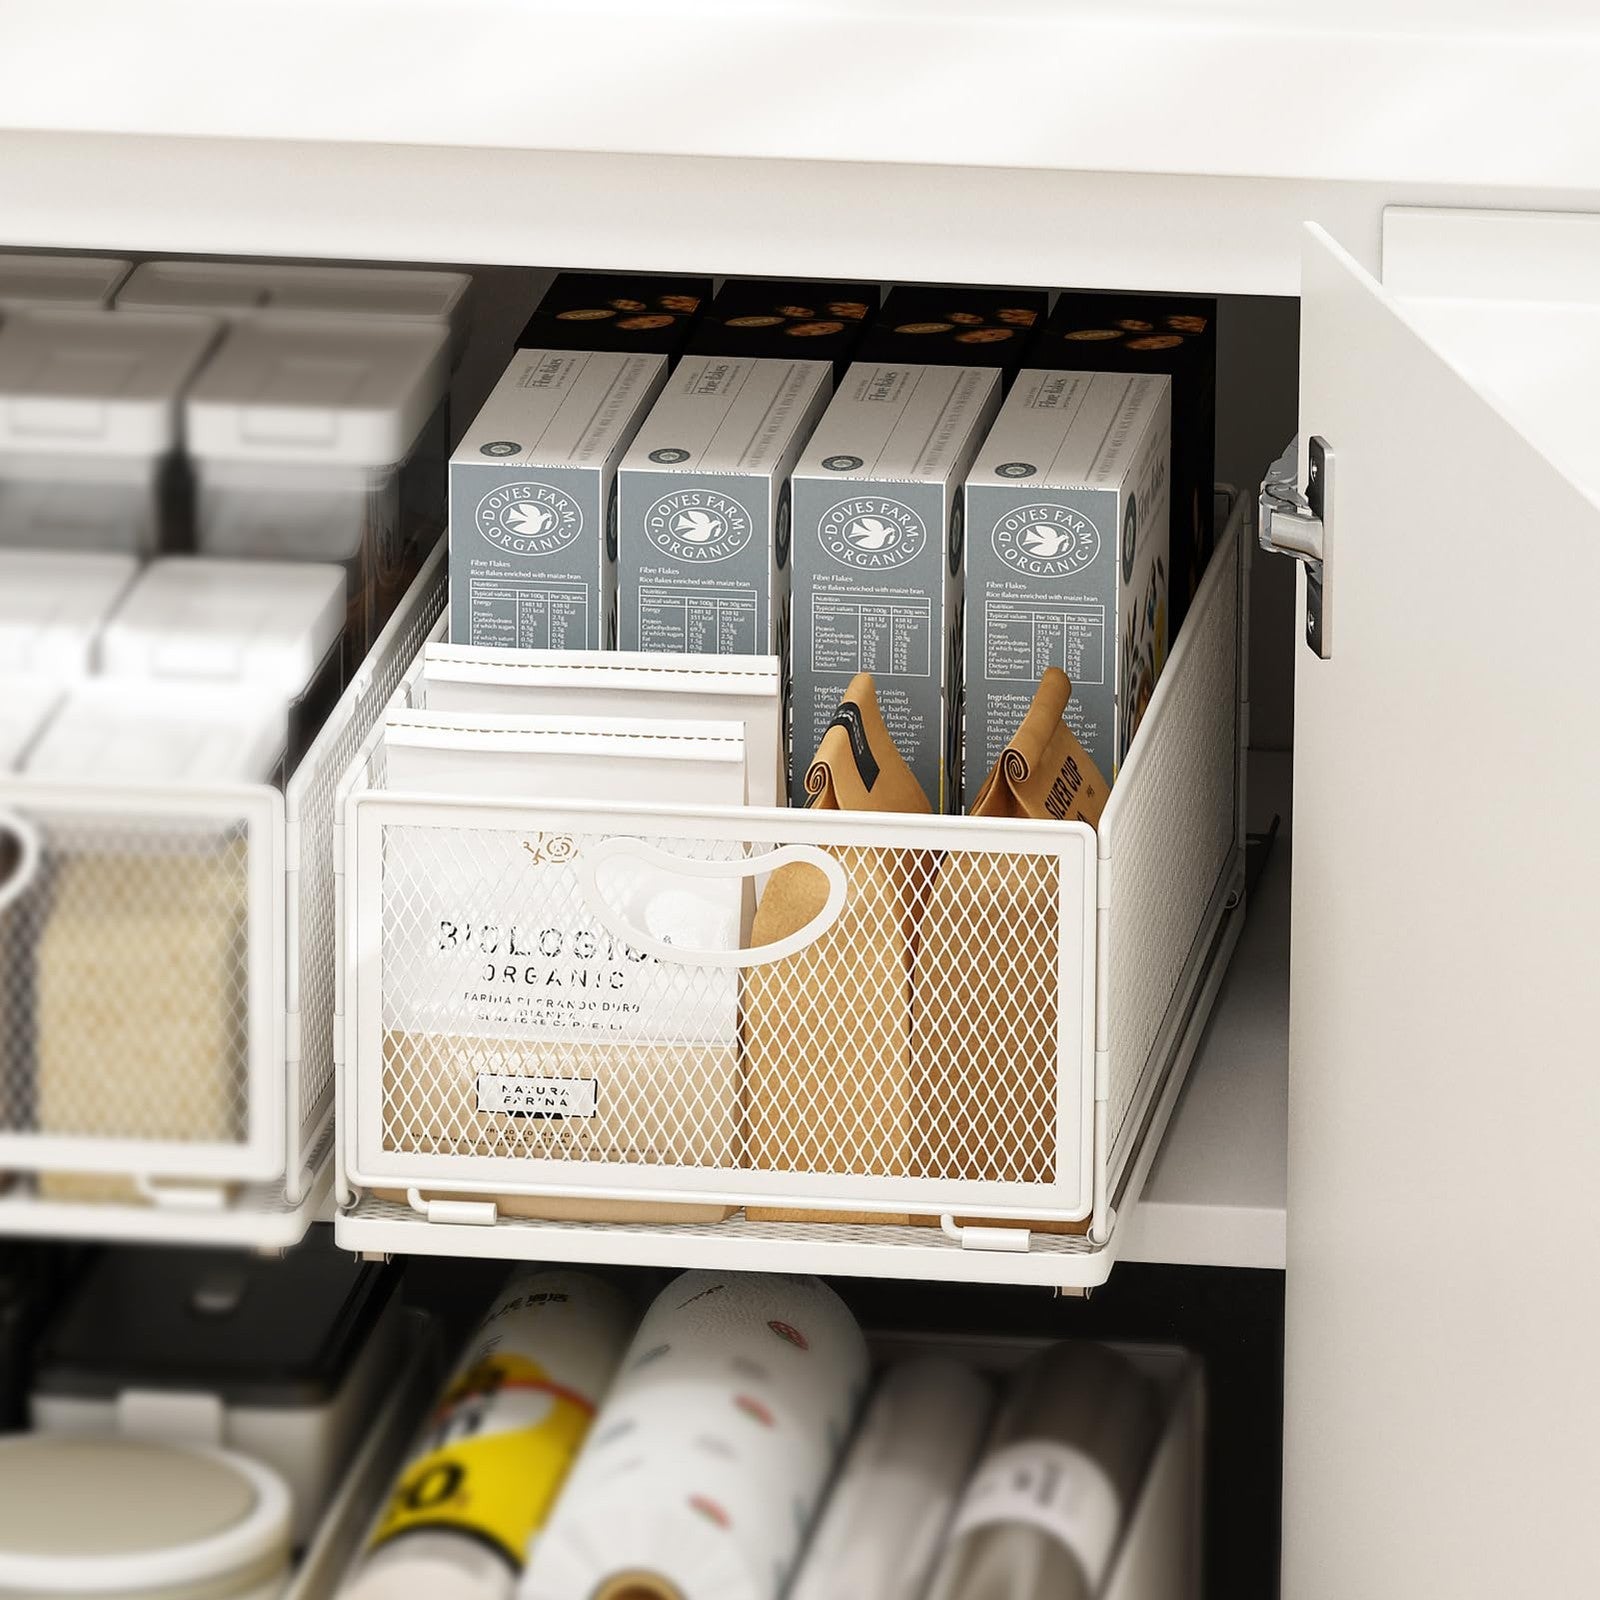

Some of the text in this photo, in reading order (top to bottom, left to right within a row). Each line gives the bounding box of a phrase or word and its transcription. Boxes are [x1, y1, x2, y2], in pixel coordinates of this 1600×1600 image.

[482, 486, 576, 523] DOVES FARM
[651, 493, 745, 530] DOVES FARM
[824, 501, 919, 538] DOVES FARM
[488, 527, 572, 552] ORGANIC
[998, 508, 1094, 545] DOVES FARM
[657, 534, 741, 559] ORGANIC
[830, 542, 915, 566] ORGANIC
[1004, 548, 1089, 574] ORGANIC
[1045, 755, 1083, 820] SILVER CUP
[483, 964, 625, 989] ORGANIC
